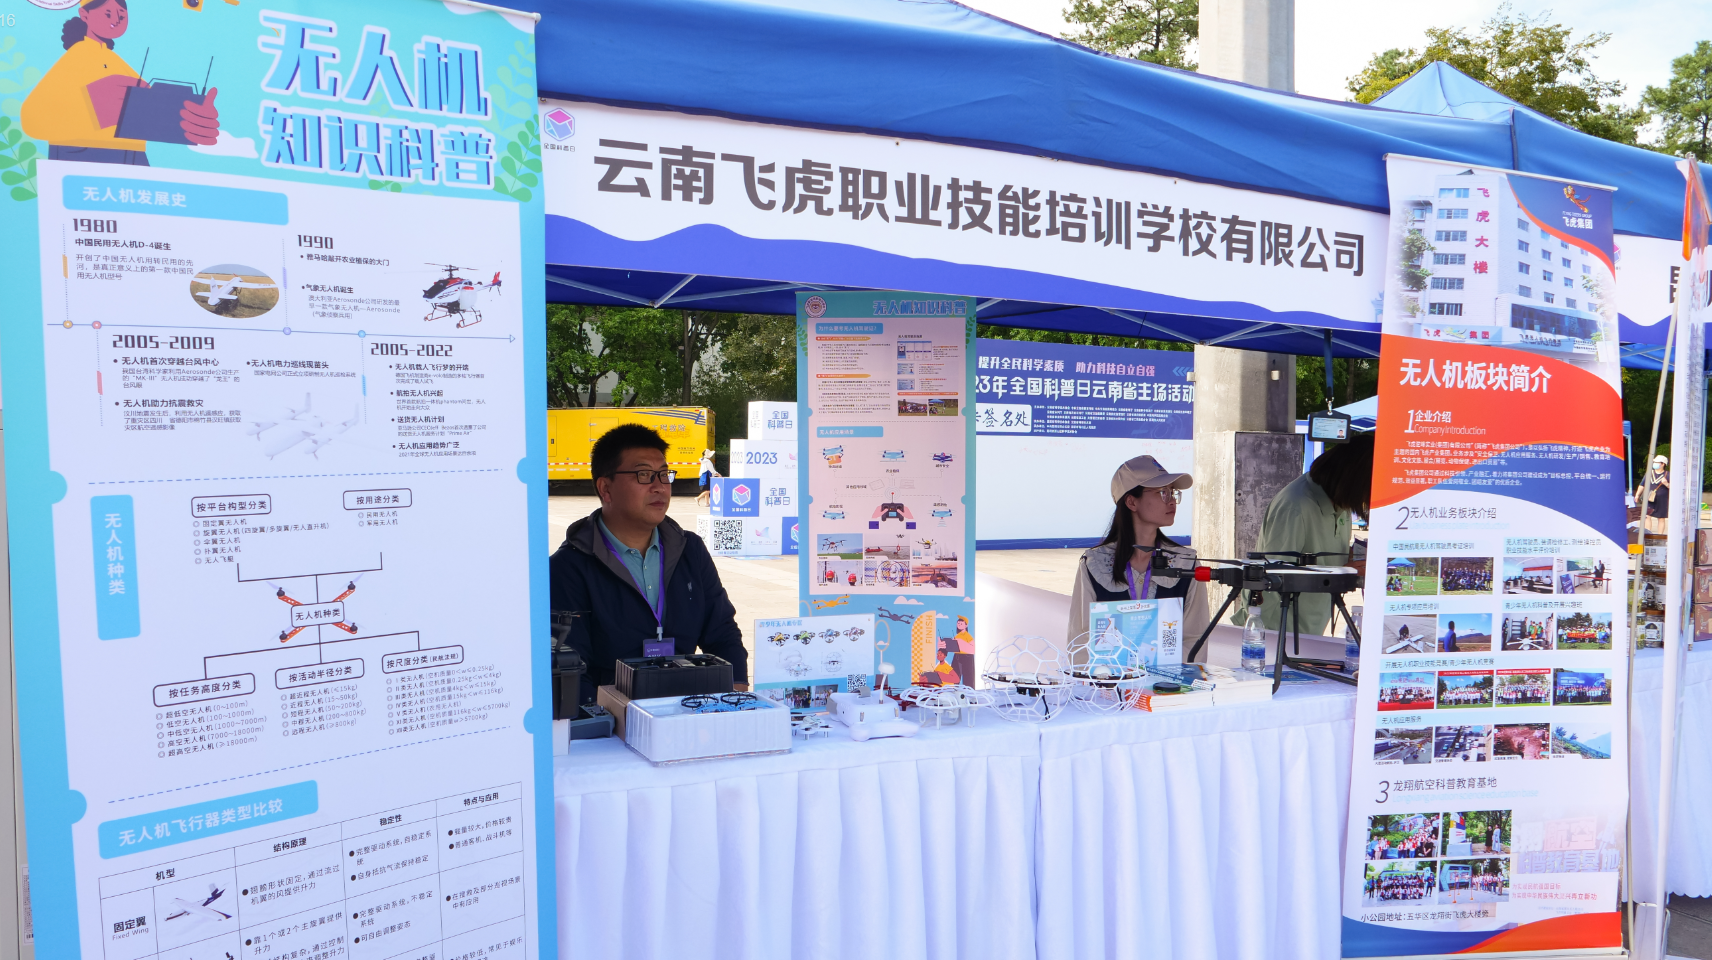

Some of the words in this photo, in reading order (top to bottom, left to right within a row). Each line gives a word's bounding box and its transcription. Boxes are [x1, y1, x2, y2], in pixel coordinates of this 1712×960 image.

[259, 12, 490, 119] 无人机
[259, 101, 494, 188] 知识科普
[82, 185, 188, 208] 无人机发展史
[593, 138, 1365, 278] 云南飞虎职业技能培训学校有限公司
[72, 217, 118, 234] 1980
[1562, 216, 1593, 230] 飞虎集团
[1473, 187, 1490, 274] 飞虎大楼
[75, 238, 172, 251] 中国民用无人机D-4诞生
[297, 234, 334, 250] 1990
[76, 271, 123, 281] 用无人机型号
[305, 283, 354, 294] 气象无人机诞生
[872, 299, 968, 316] 无人机知识科普
[1423, 328, 1441, 338] 飞虎
[1469, 330, 1490, 340] 集团
[112, 334, 215, 350] 2005-2009
[370, 342, 453, 357] 2005-2022
[121, 356, 220, 367] 无人机首次穿越台风中心
[250, 358, 330, 369] 无人机电力巡线现苗头
[394, 363, 470, 372] 无人机载人飞行梦的开端
[978, 355, 1065, 373] 提升全民科学素质
[1075, 360, 1156, 378] 助力科技自立自强
[1400, 358, 1552, 394] 无人机板块简介
[396, 389, 444, 398] 航拍无人机兴起
[123, 398, 204, 408] 无人机助力抗震救灾
[397, 415, 445, 424] 送货无人机计划
[772, 410, 789, 420] 全国
[1414, 410, 1452, 424] 企业介绍
[767, 420, 793, 430] 科普日
[398, 441, 460, 450] 无人机应用趋势广泛
[746, 452, 778, 465] 2023
[770, 488, 786, 497] 全国
[196, 500, 268, 512] 按平台构型分类
[356, 494, 400, 506] 按用途分类
[1395, 506, 1410, 530] 2
[1410, 506, 1497, 520] 无人机业务板块介绍
[104, 512, 126, 596] 无人机种类
[295, 607, 341, 621] 无人机种类
[925, 614, 933, 644] FINISH
[288, 665, 353, 683] 按活动半径分类
[168, 679, 242, 699] 按任务高度分类
[1381, 716, 1422, 725] 无人机应用服务
[1393, 776, 1498, 792] 龙翔航空科普教育基地
[463, 791, 500, 807] 特点与应用
[1375, 780, 1390, 804] 3
[118, 798, 284, 847] 无人机飞行器类型比较
[379, 813, 403, 827] 稳定性
[272, 836, 308, 853] 结构原理
[155, 867, 176, 881] 机型
[250, 880, 317, 906] 机翼的风提供升力
[112, 915, 148, 934] 固定翼
[360, 917, 376, 928] 系统
[112, 930, 130, 941] Fixed
[132, 927, 150, 938] Wing
[361, 920, 412, 942] 可自由调整姿态
[254, 944, 272, 956] 升力
